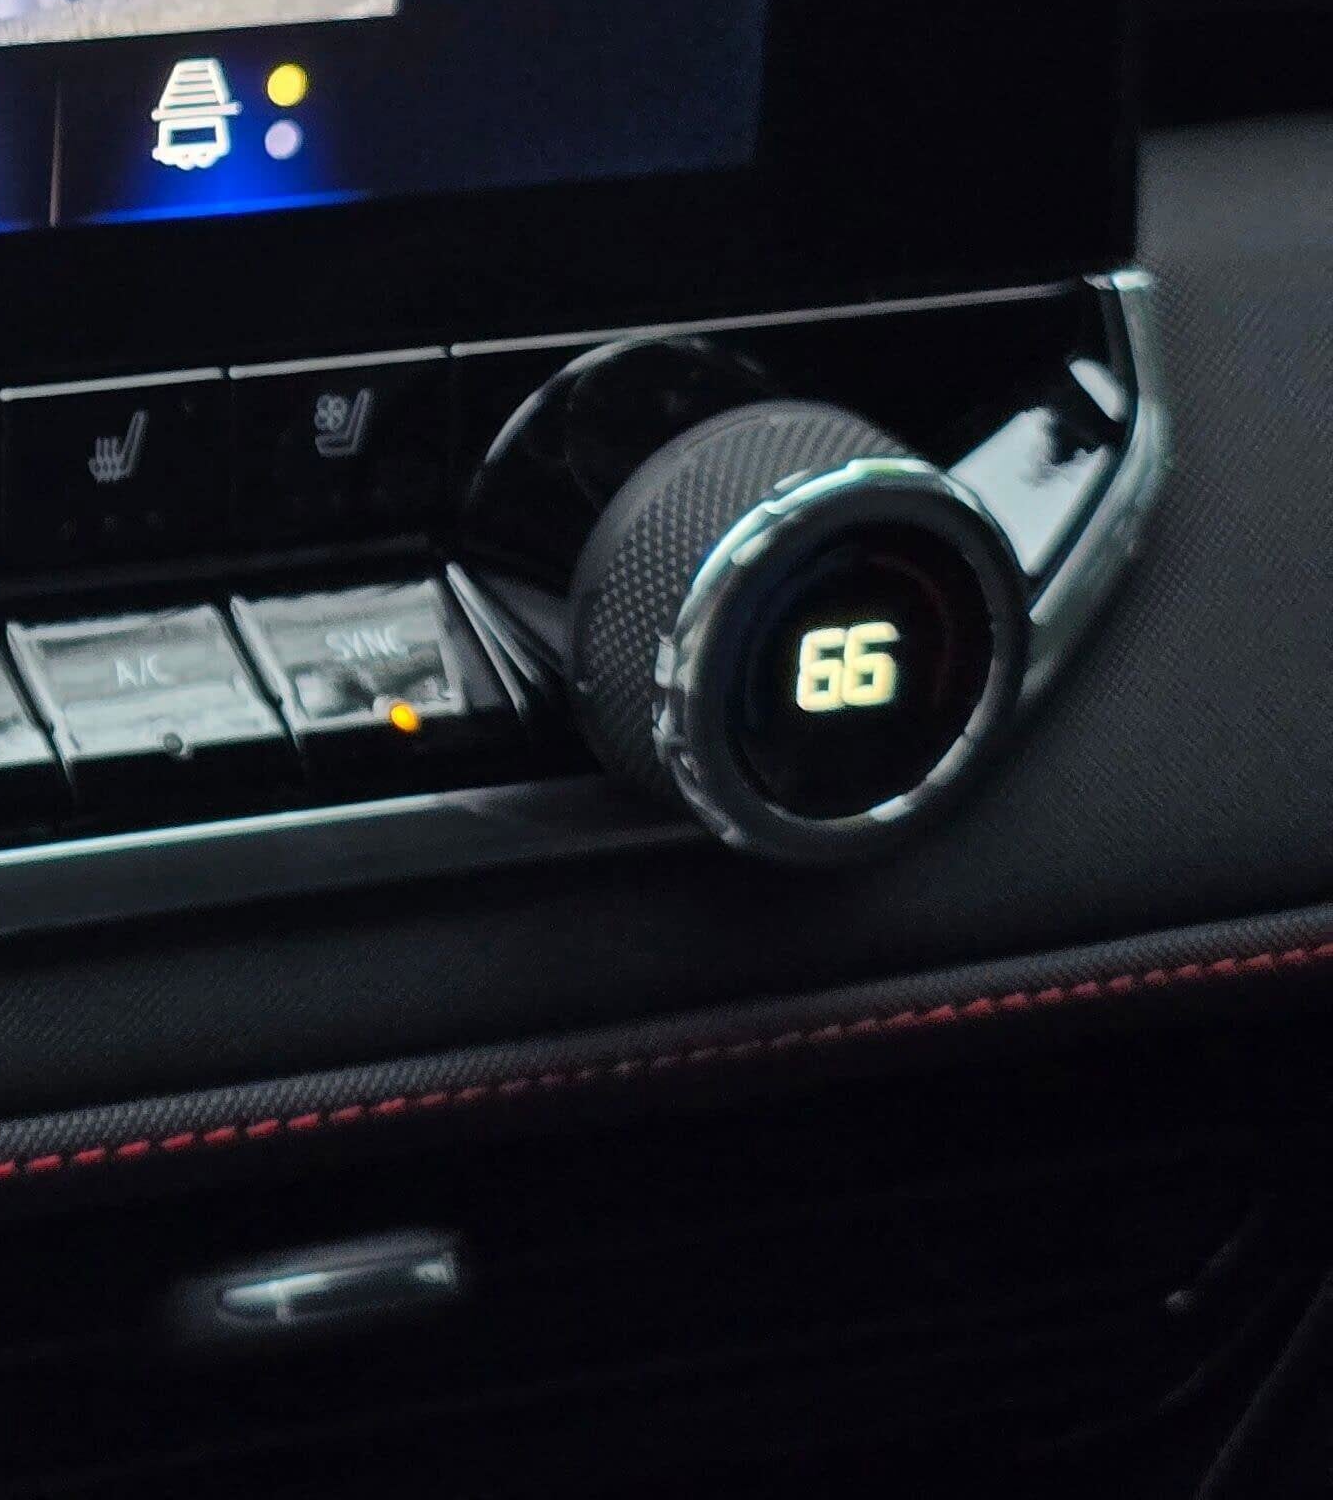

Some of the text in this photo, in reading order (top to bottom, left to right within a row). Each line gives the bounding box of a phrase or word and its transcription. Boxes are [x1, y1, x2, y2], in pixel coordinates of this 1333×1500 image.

[325, 622, 409, 661] SYNC
[114, 651, 174, 687] A/C
[796, 620, 900, 712] 66
